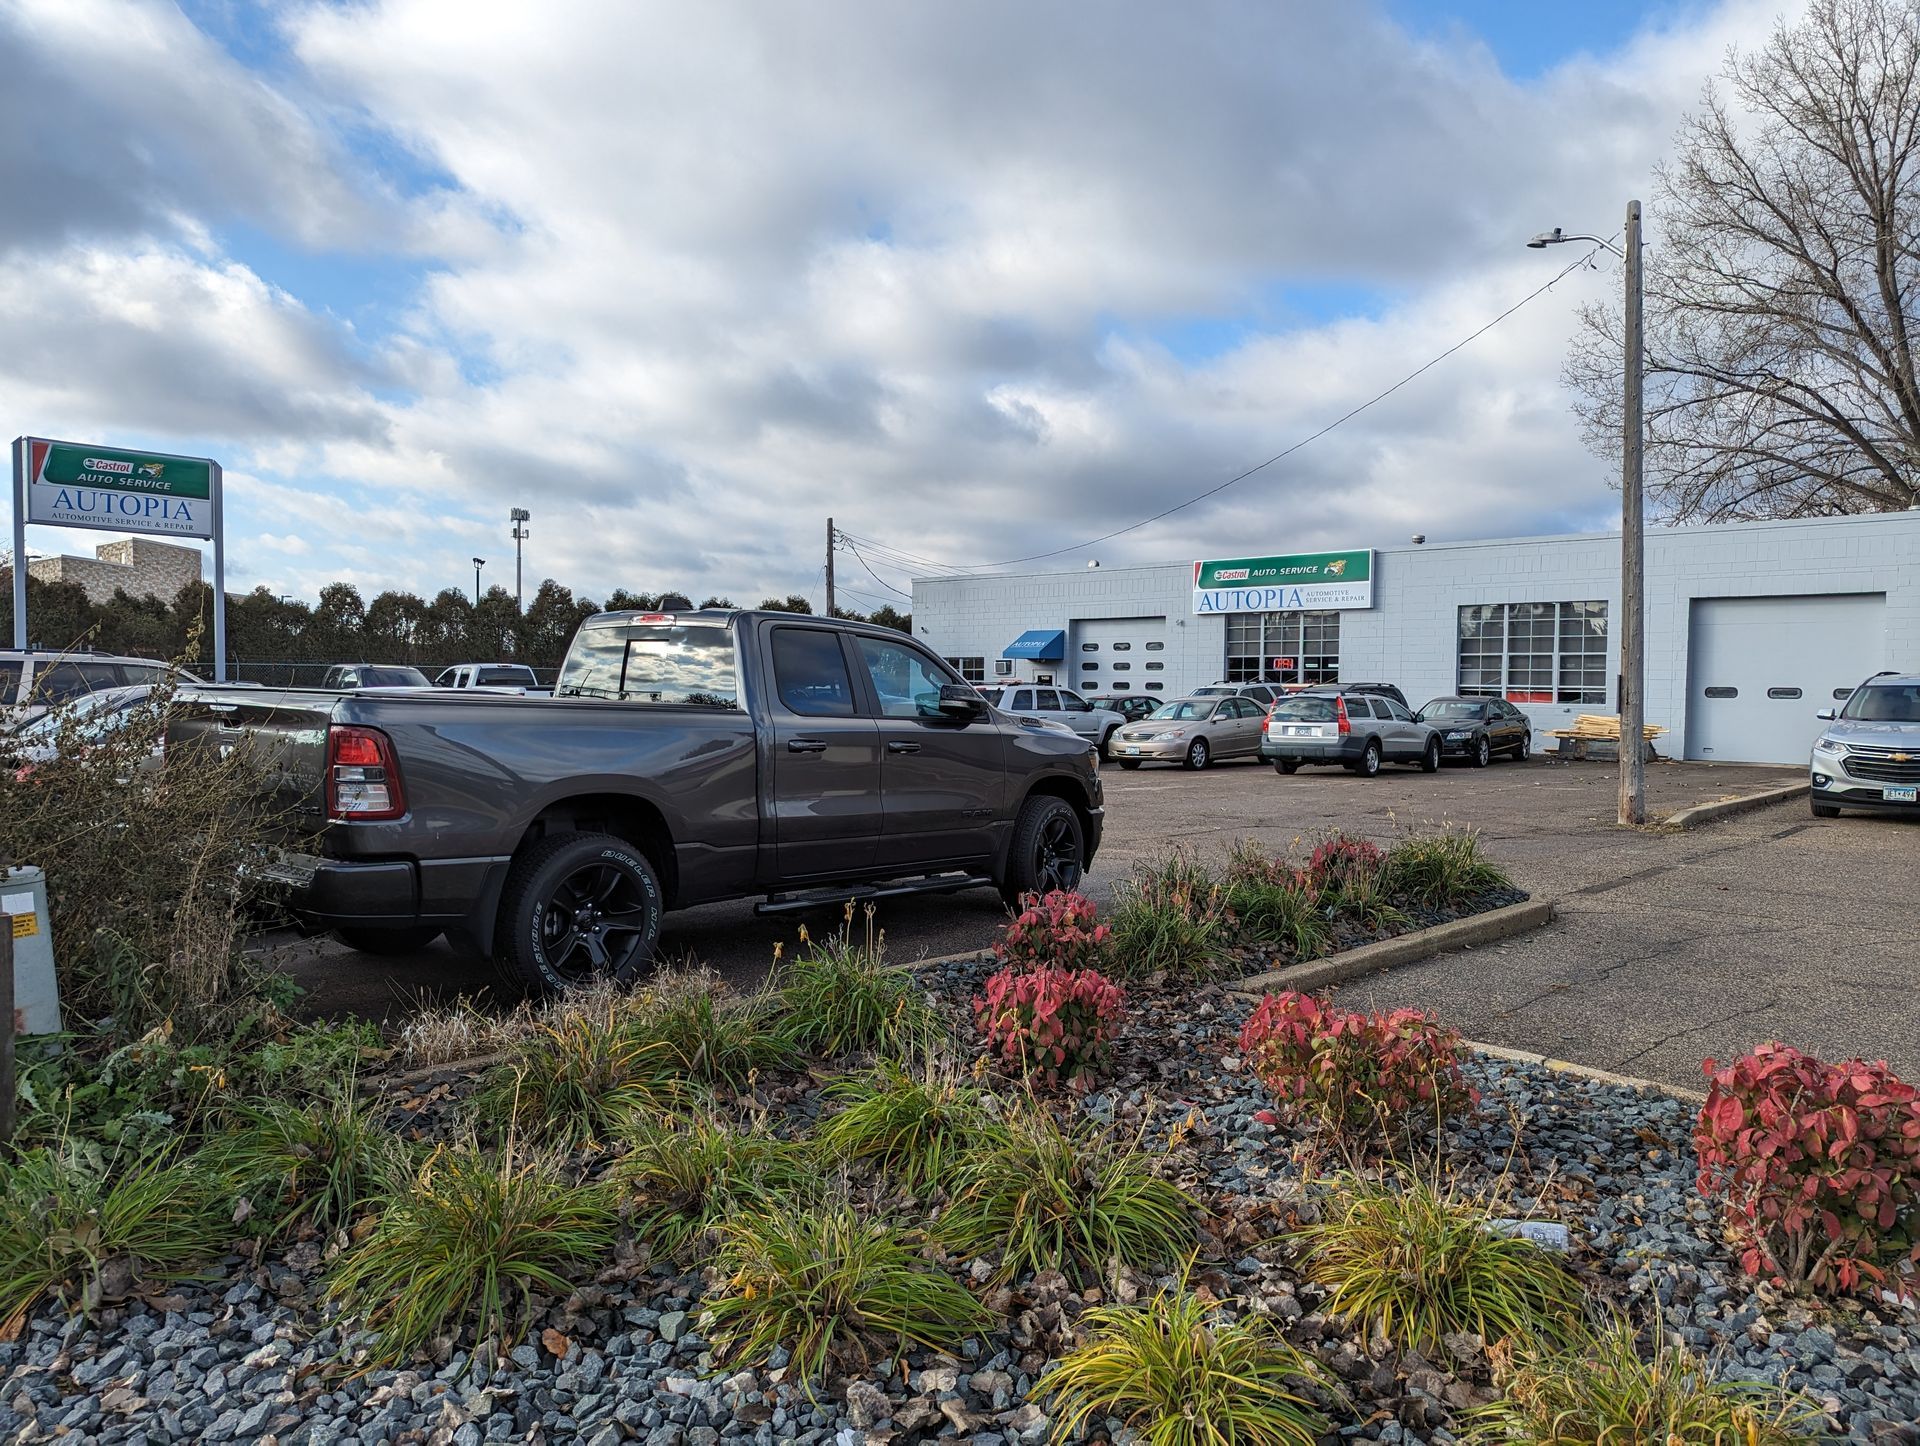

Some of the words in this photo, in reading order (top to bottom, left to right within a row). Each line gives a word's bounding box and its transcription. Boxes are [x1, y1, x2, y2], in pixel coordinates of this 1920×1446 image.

[95, 460, 130, 473] Castrol
[77, 473, 113, 484] AUTO
[118, 477, 172, 490] SERVICE
[52, 488, 194, 521] AUTOPIA
[52, 512, 112, 524] AUTOMOTIVE
[115, 517, 152, 527] SERVICE
[164, 522, 194, 531] REPAIR
[1222, 570, 1248, 579] Castrol
[1252, 568, 1277, 577] AUTO
[1280, 565, 1318, 575] SERVICE
[1198, 588, 1304, 611] AUTOPIA
[1306, 589, 1349, 597] AUTOMOTIVE
[601, 850, 656, 898] DUELER
